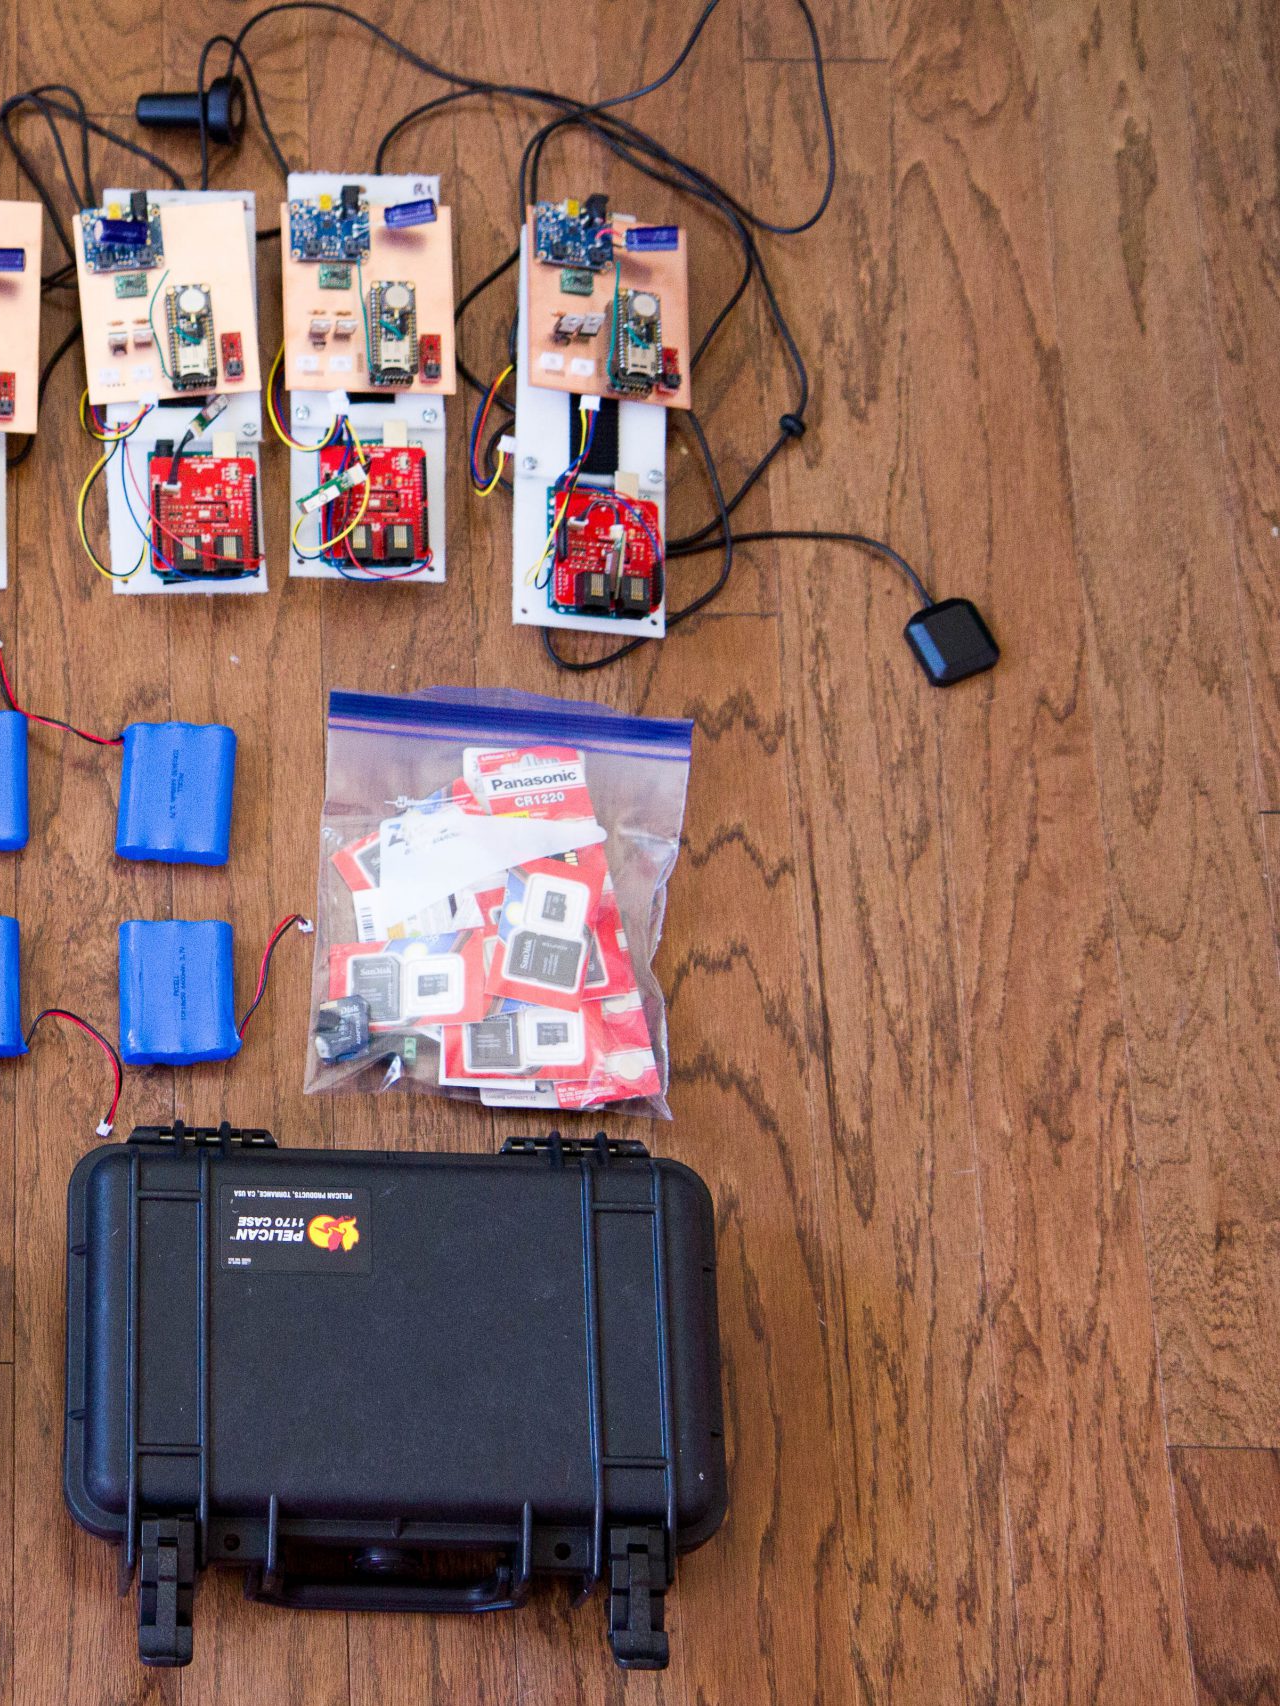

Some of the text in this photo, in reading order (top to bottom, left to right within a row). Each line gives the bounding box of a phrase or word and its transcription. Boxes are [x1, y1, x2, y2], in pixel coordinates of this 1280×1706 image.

[491, 769, 577, 791] Panasonic
[514, 792, 565, 808] CR1220
[292, 1191, 326, 1199] PRODUCTS,
[327, 1192, 353, 1200] PELICAN
[237, 1216, 305, 1227] 1170 CASE
